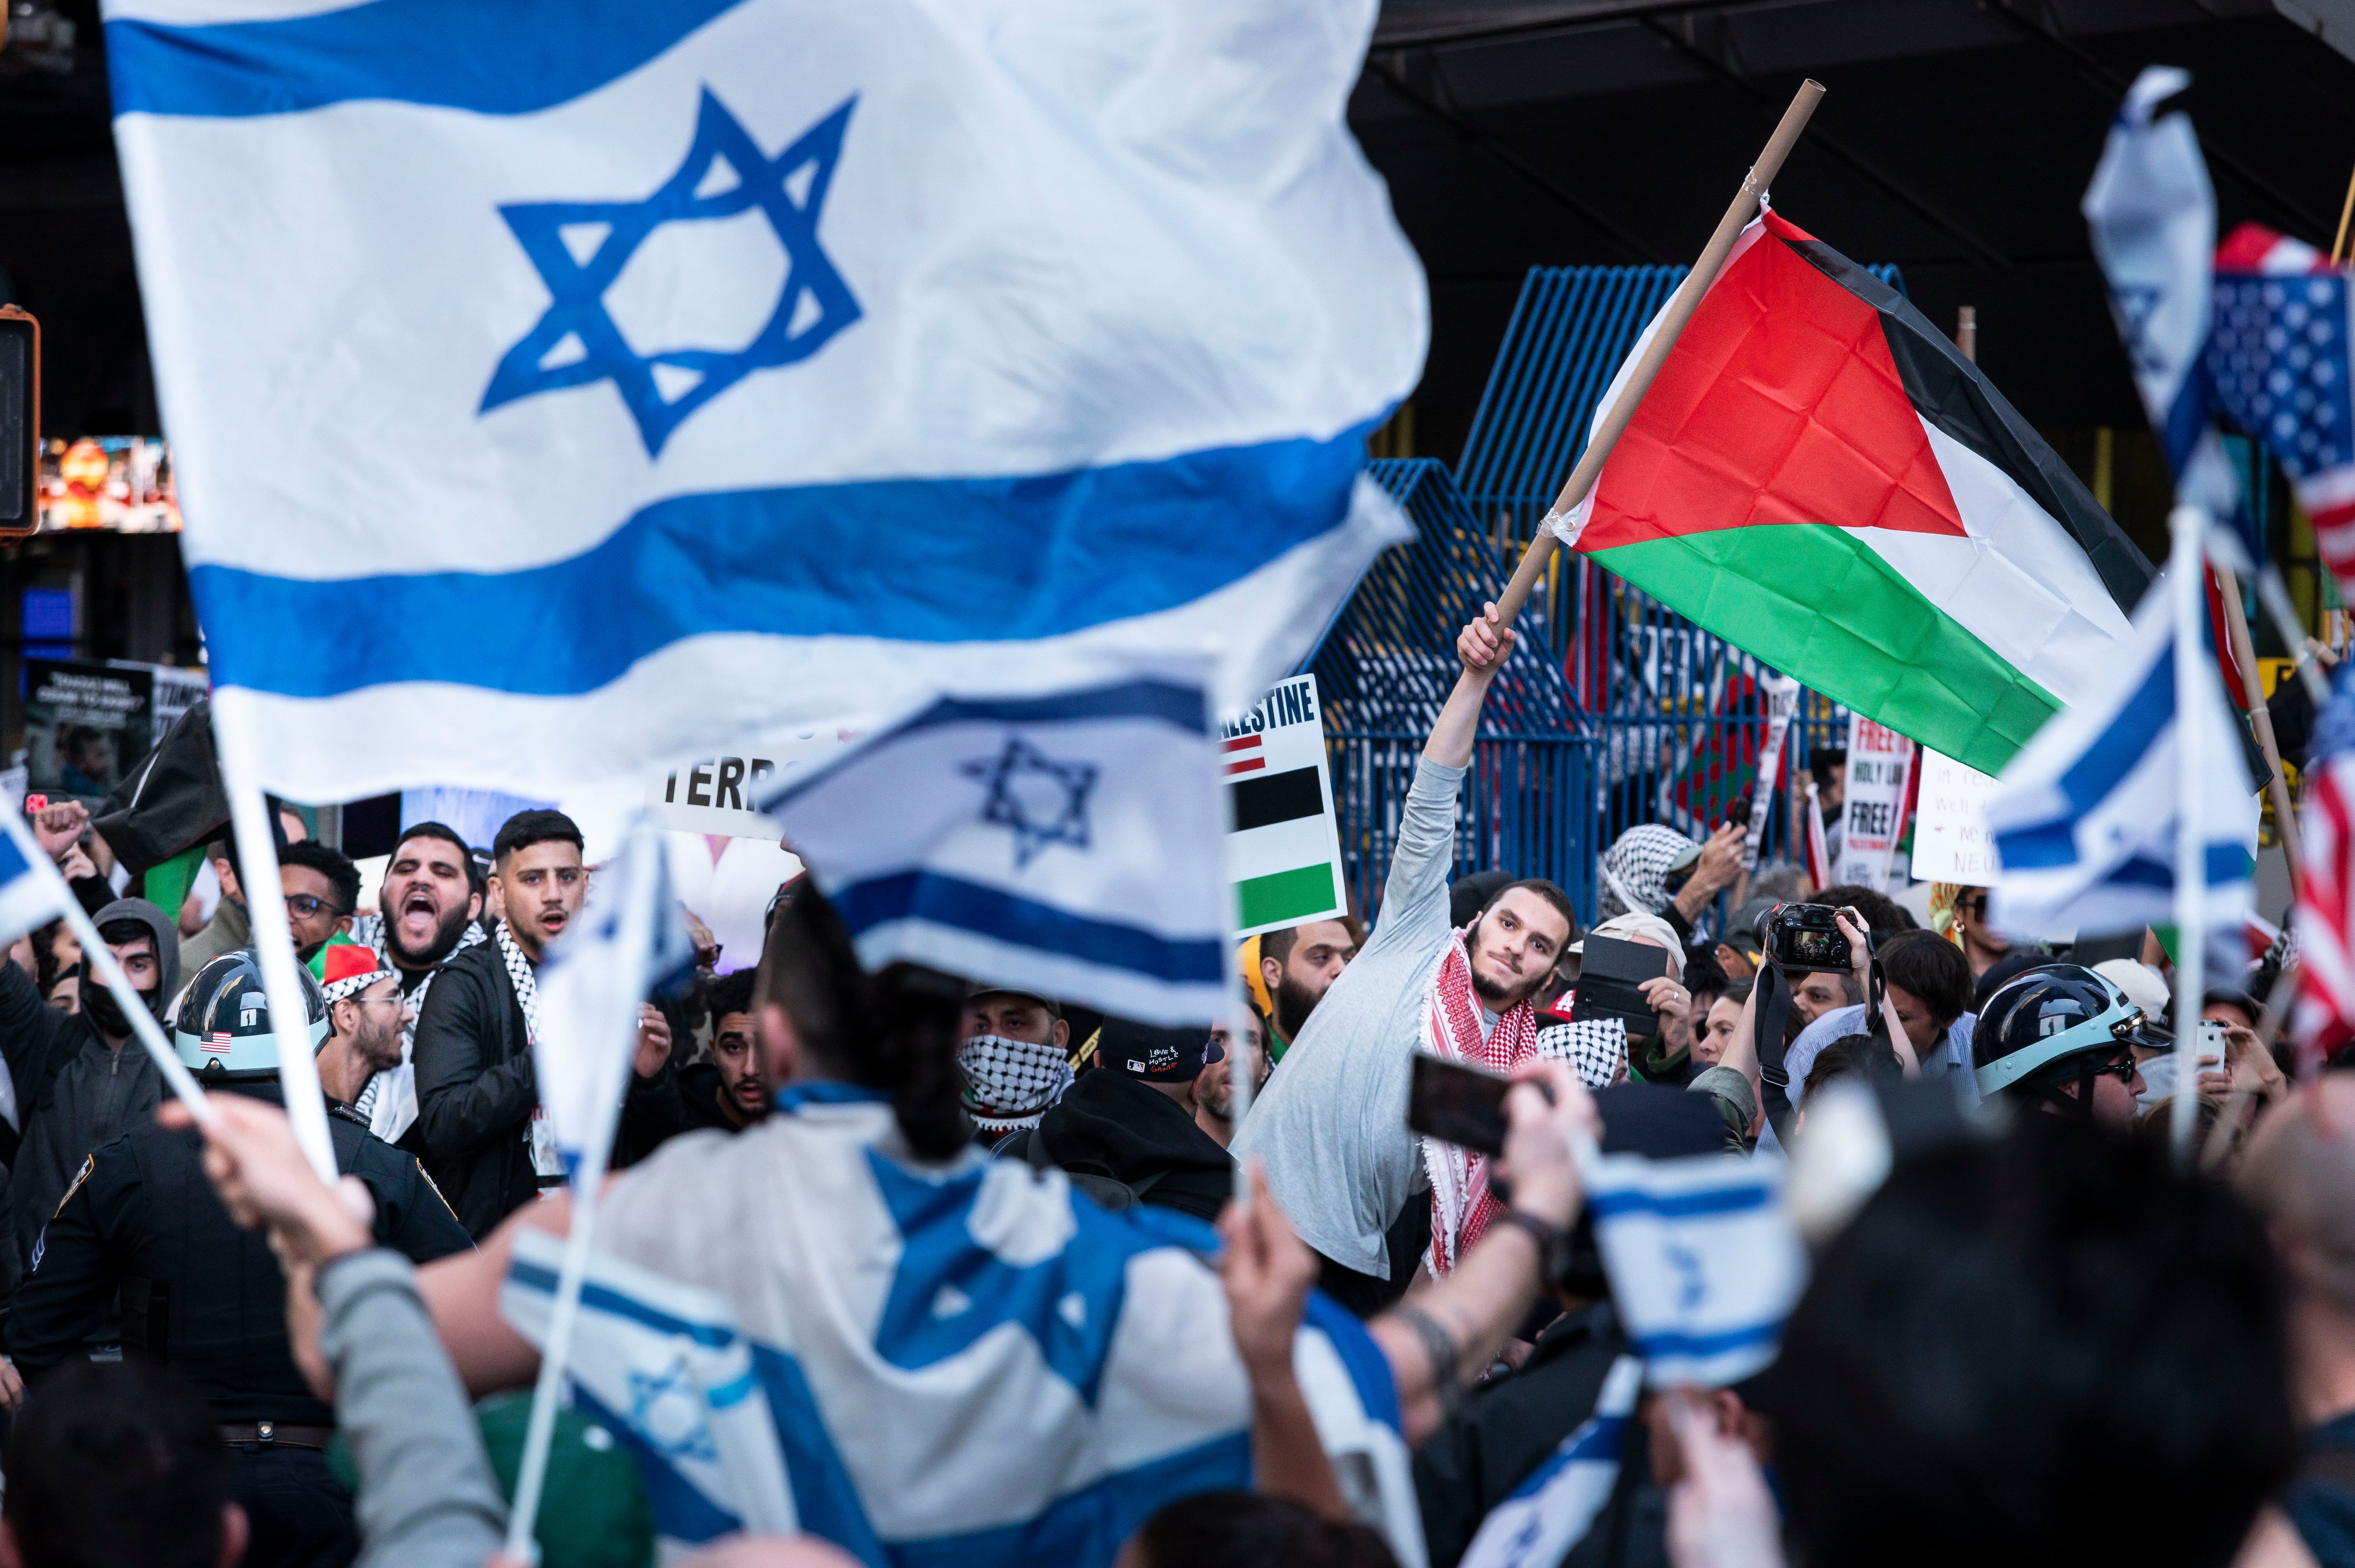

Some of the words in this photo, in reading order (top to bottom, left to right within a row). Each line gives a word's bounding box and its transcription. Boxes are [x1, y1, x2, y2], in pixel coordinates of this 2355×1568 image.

[1850, 800, 1887, 835] FREE
[1954, 851, 1995, 874] NEU
[1149, 1052, 1178, 1066] HUSTLE
[1150, 1049, 1169, 1058] LOVE
[1151, 1062, 1178, 1073] GAME
